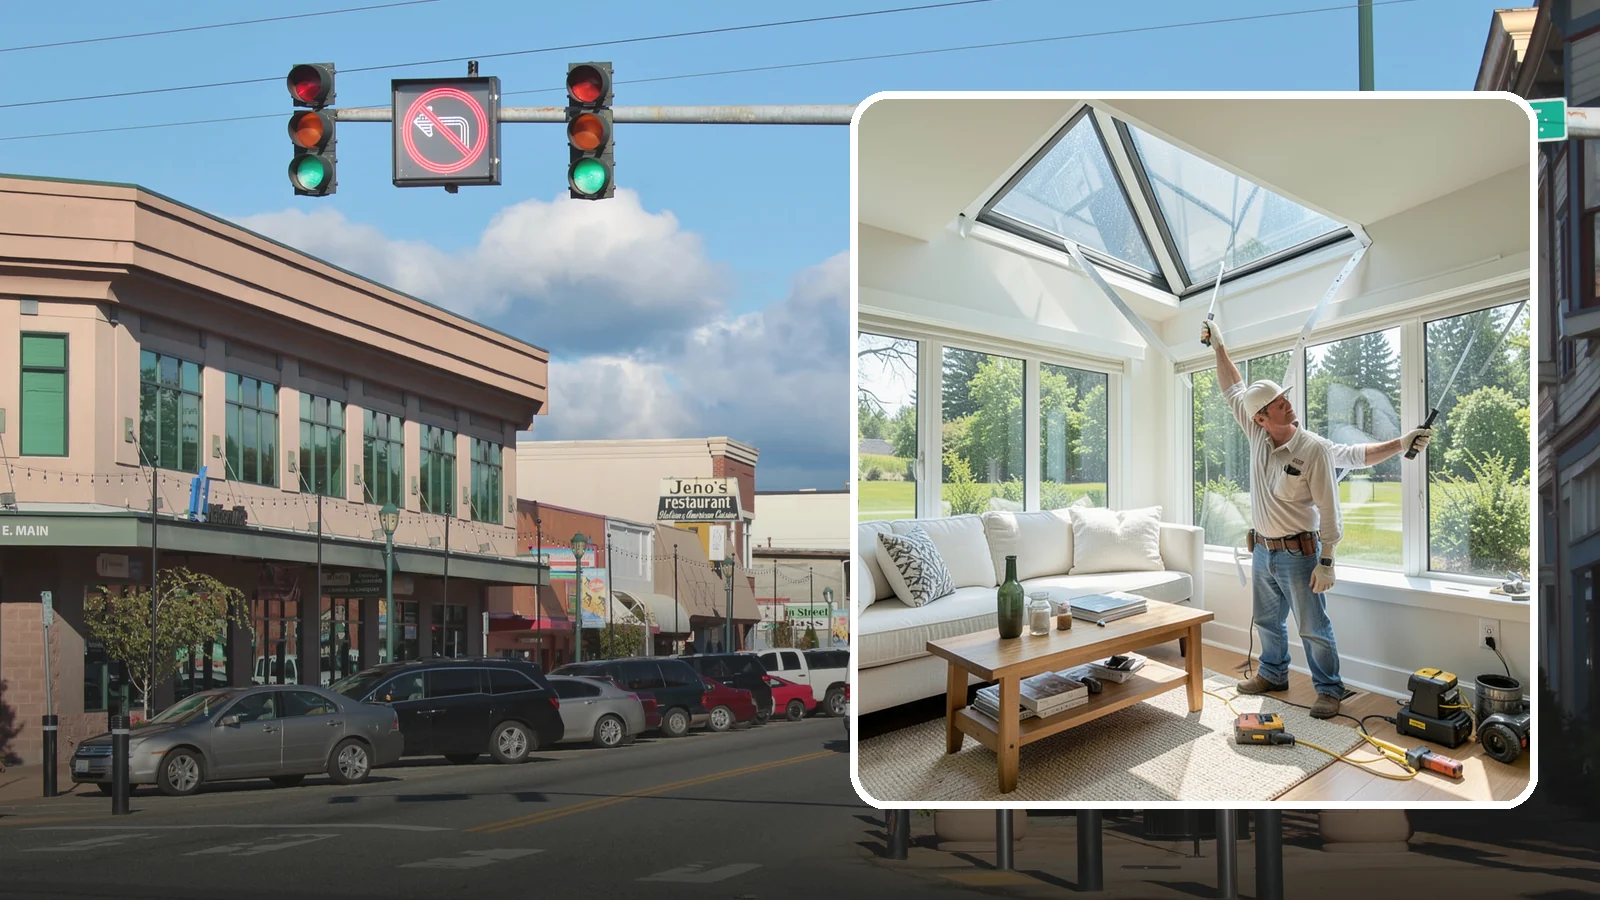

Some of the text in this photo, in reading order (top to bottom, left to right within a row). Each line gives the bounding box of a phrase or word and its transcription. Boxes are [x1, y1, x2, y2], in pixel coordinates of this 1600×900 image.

[669, 480, 727, 494] Jeno's
[665, 496, 731, 509] restaurant
[658, 510, 682, 519] Italian
[686, 509, 714, 519] American
[714, 509, 738, 519] Cuisine
[2, 525, 49, 536] E. MAIN
[797, 607, 828, 617] Street
